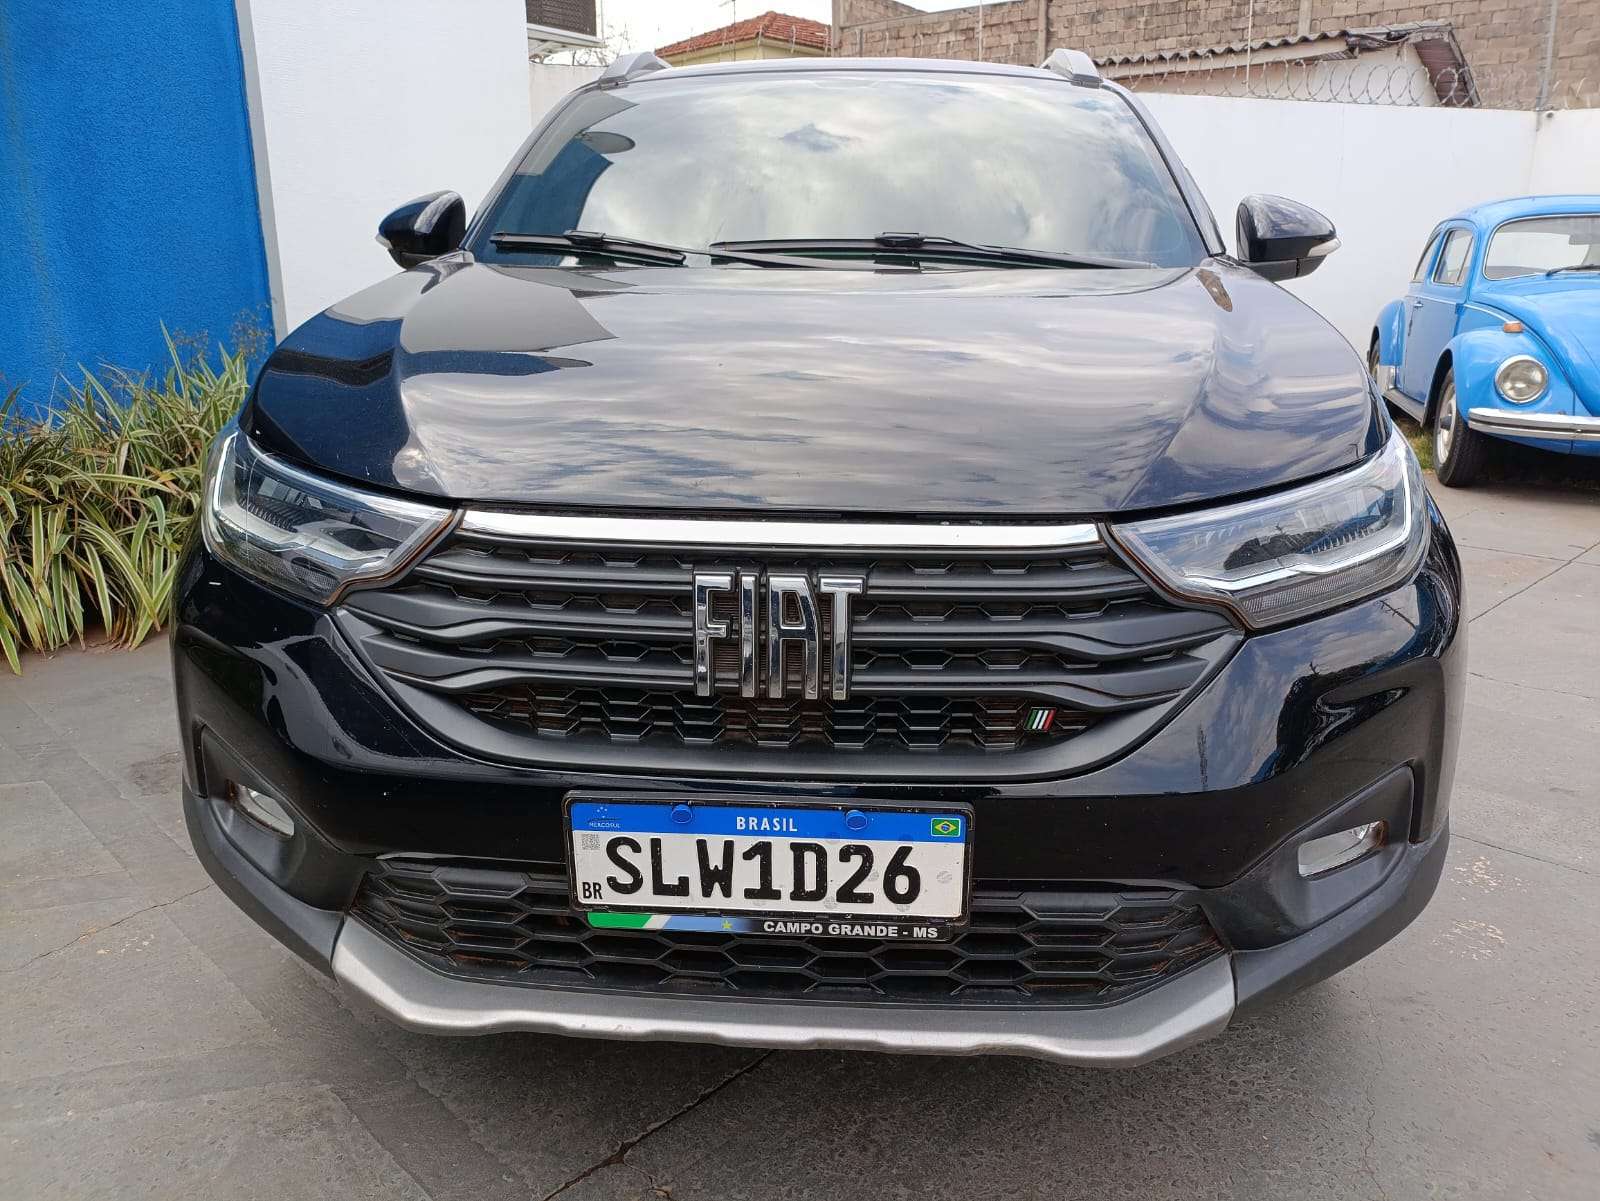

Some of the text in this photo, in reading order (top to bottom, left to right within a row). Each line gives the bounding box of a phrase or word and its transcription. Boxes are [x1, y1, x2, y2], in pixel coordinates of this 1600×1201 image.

[694, 572, 865, 700] FIAT
[736, 816, 798, 832] BRASIL
[606, 836, 921, 905] SLW1D26
[582, 881, 603, 900] BR
[763, 921, 823, 935] CAMPO
[827, 923, 898, 938] GRANDE
[913, 927, 938, 938] MS
